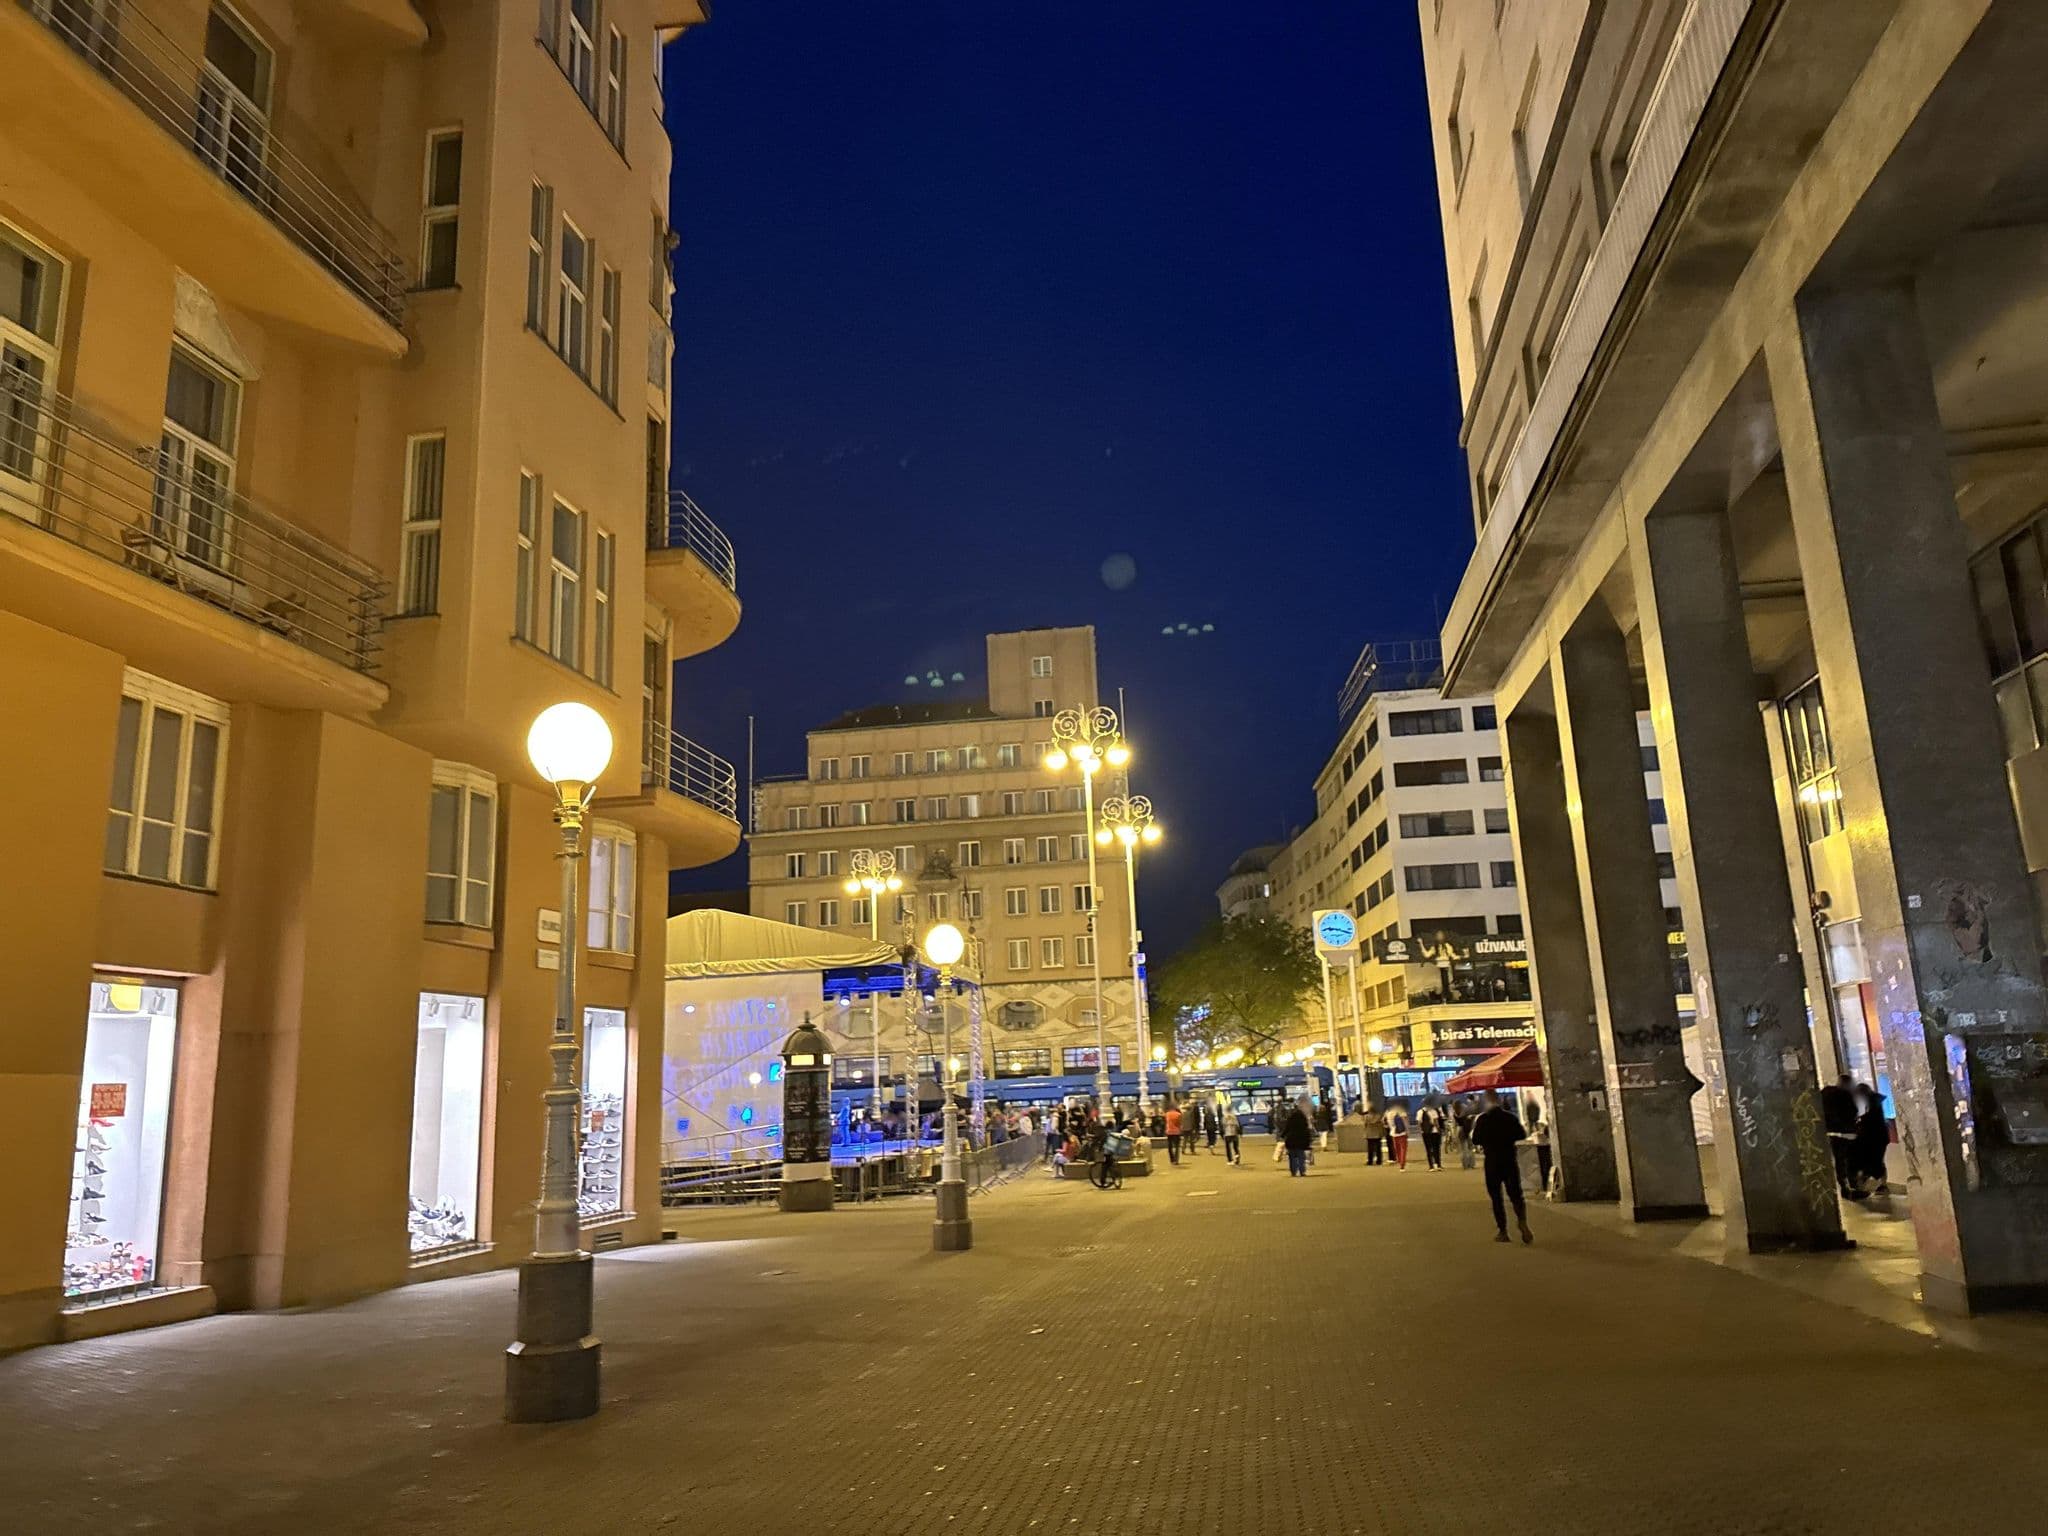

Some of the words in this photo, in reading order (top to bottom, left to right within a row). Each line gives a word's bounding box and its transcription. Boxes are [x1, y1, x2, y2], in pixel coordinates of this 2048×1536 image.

[1475, 939, 1527, 953] UŽIVANJE
[1440, 1028, 1473, 1041] biraš
[1474, 1026, 1535, 1039] Telemach
